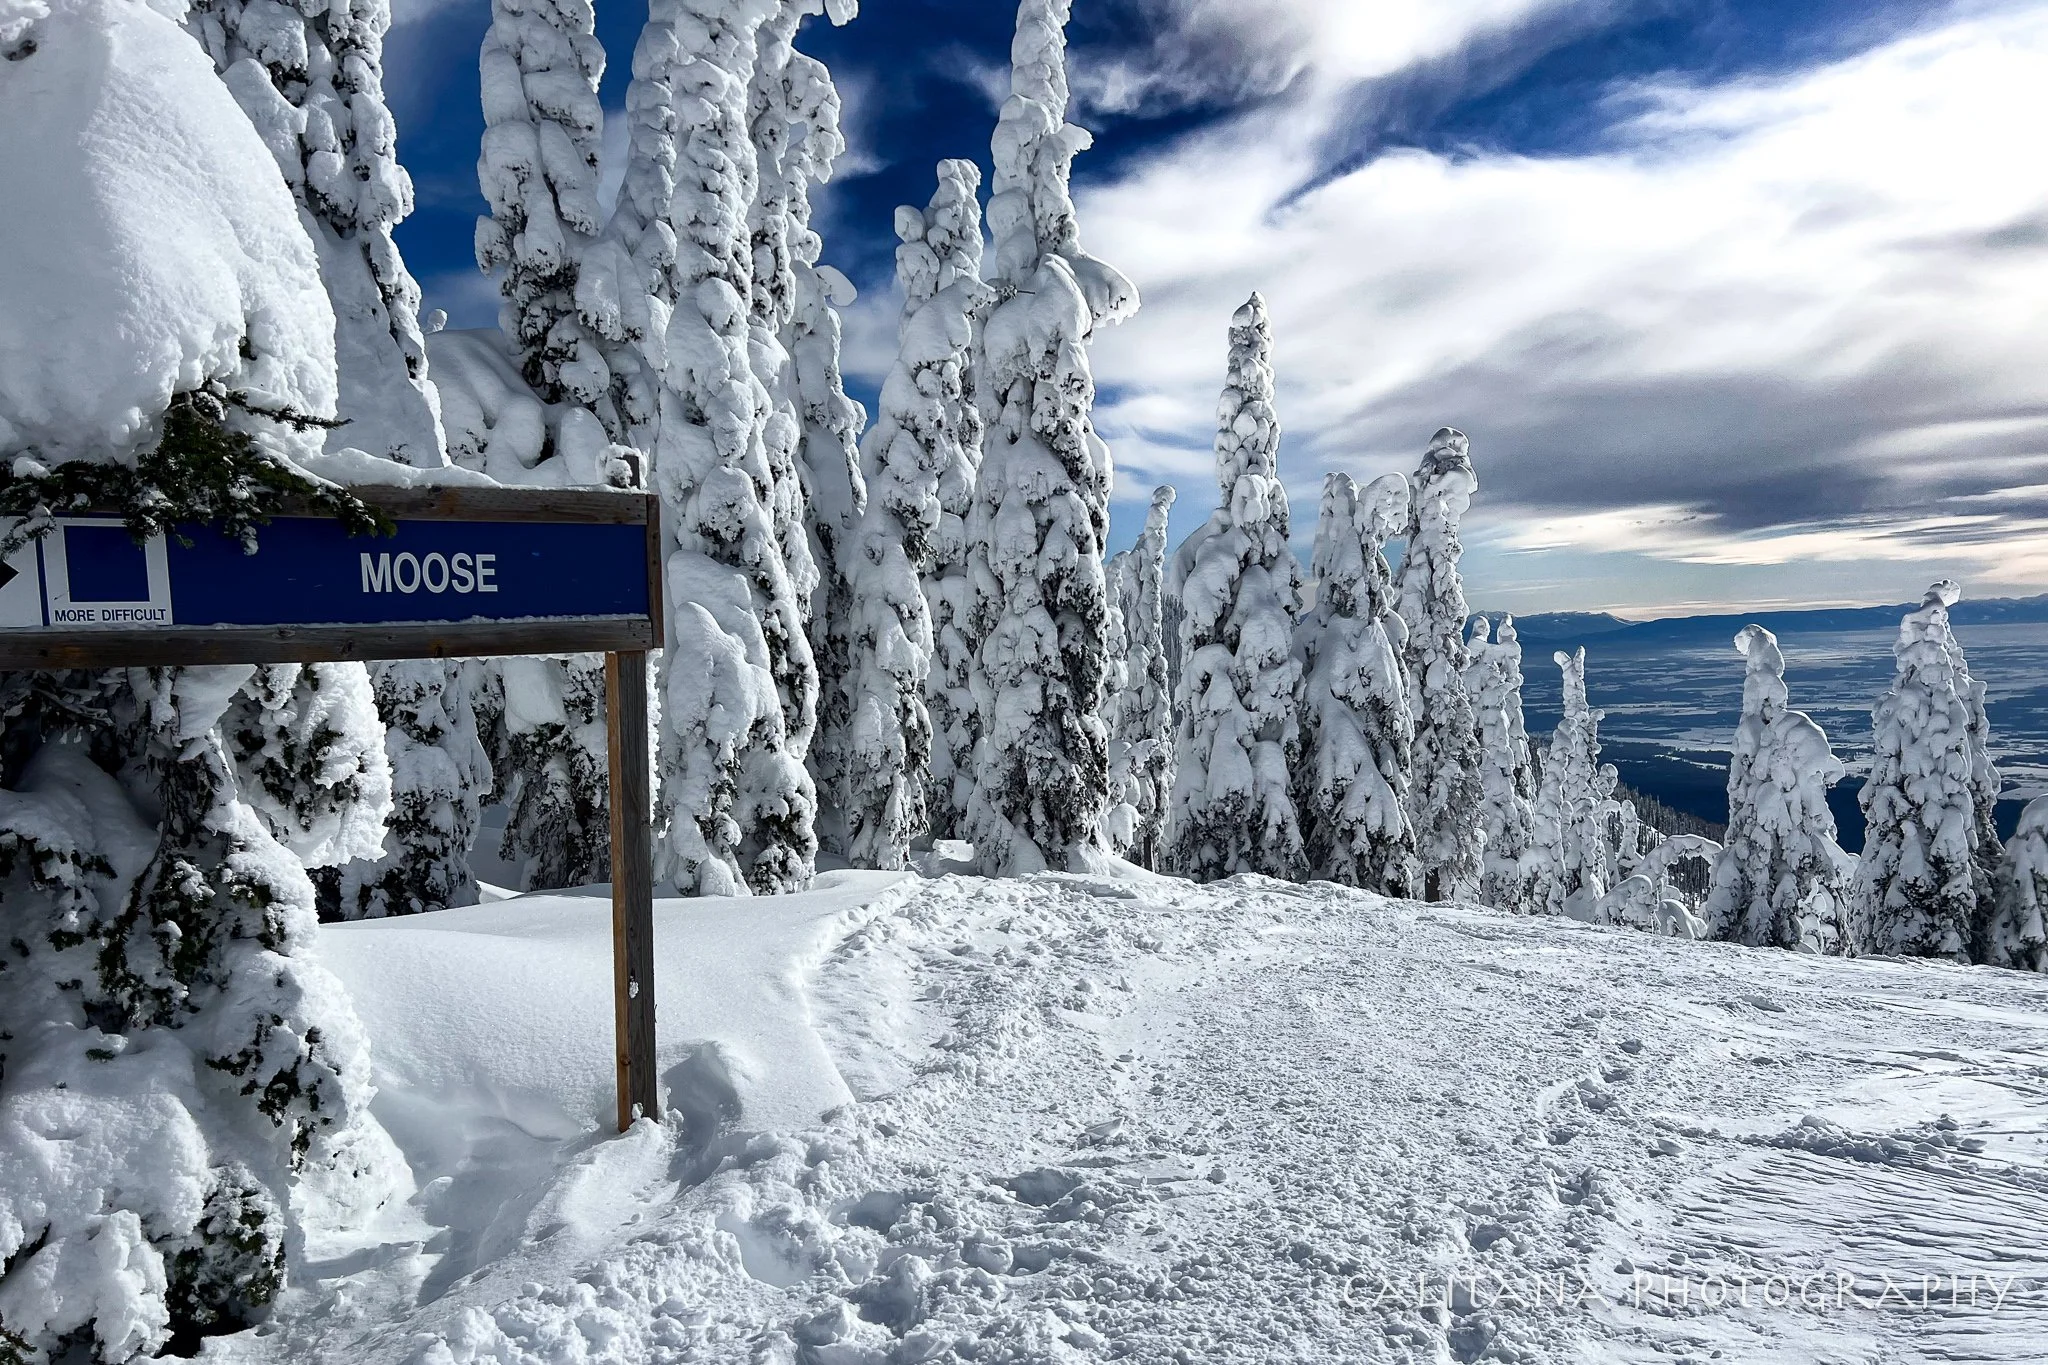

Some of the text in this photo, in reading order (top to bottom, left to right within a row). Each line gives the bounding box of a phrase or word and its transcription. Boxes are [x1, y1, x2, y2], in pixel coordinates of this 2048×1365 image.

[360, 552, 498, 594] MOOSE
[55, 608, 166, 622] MORE DIFFICULT
